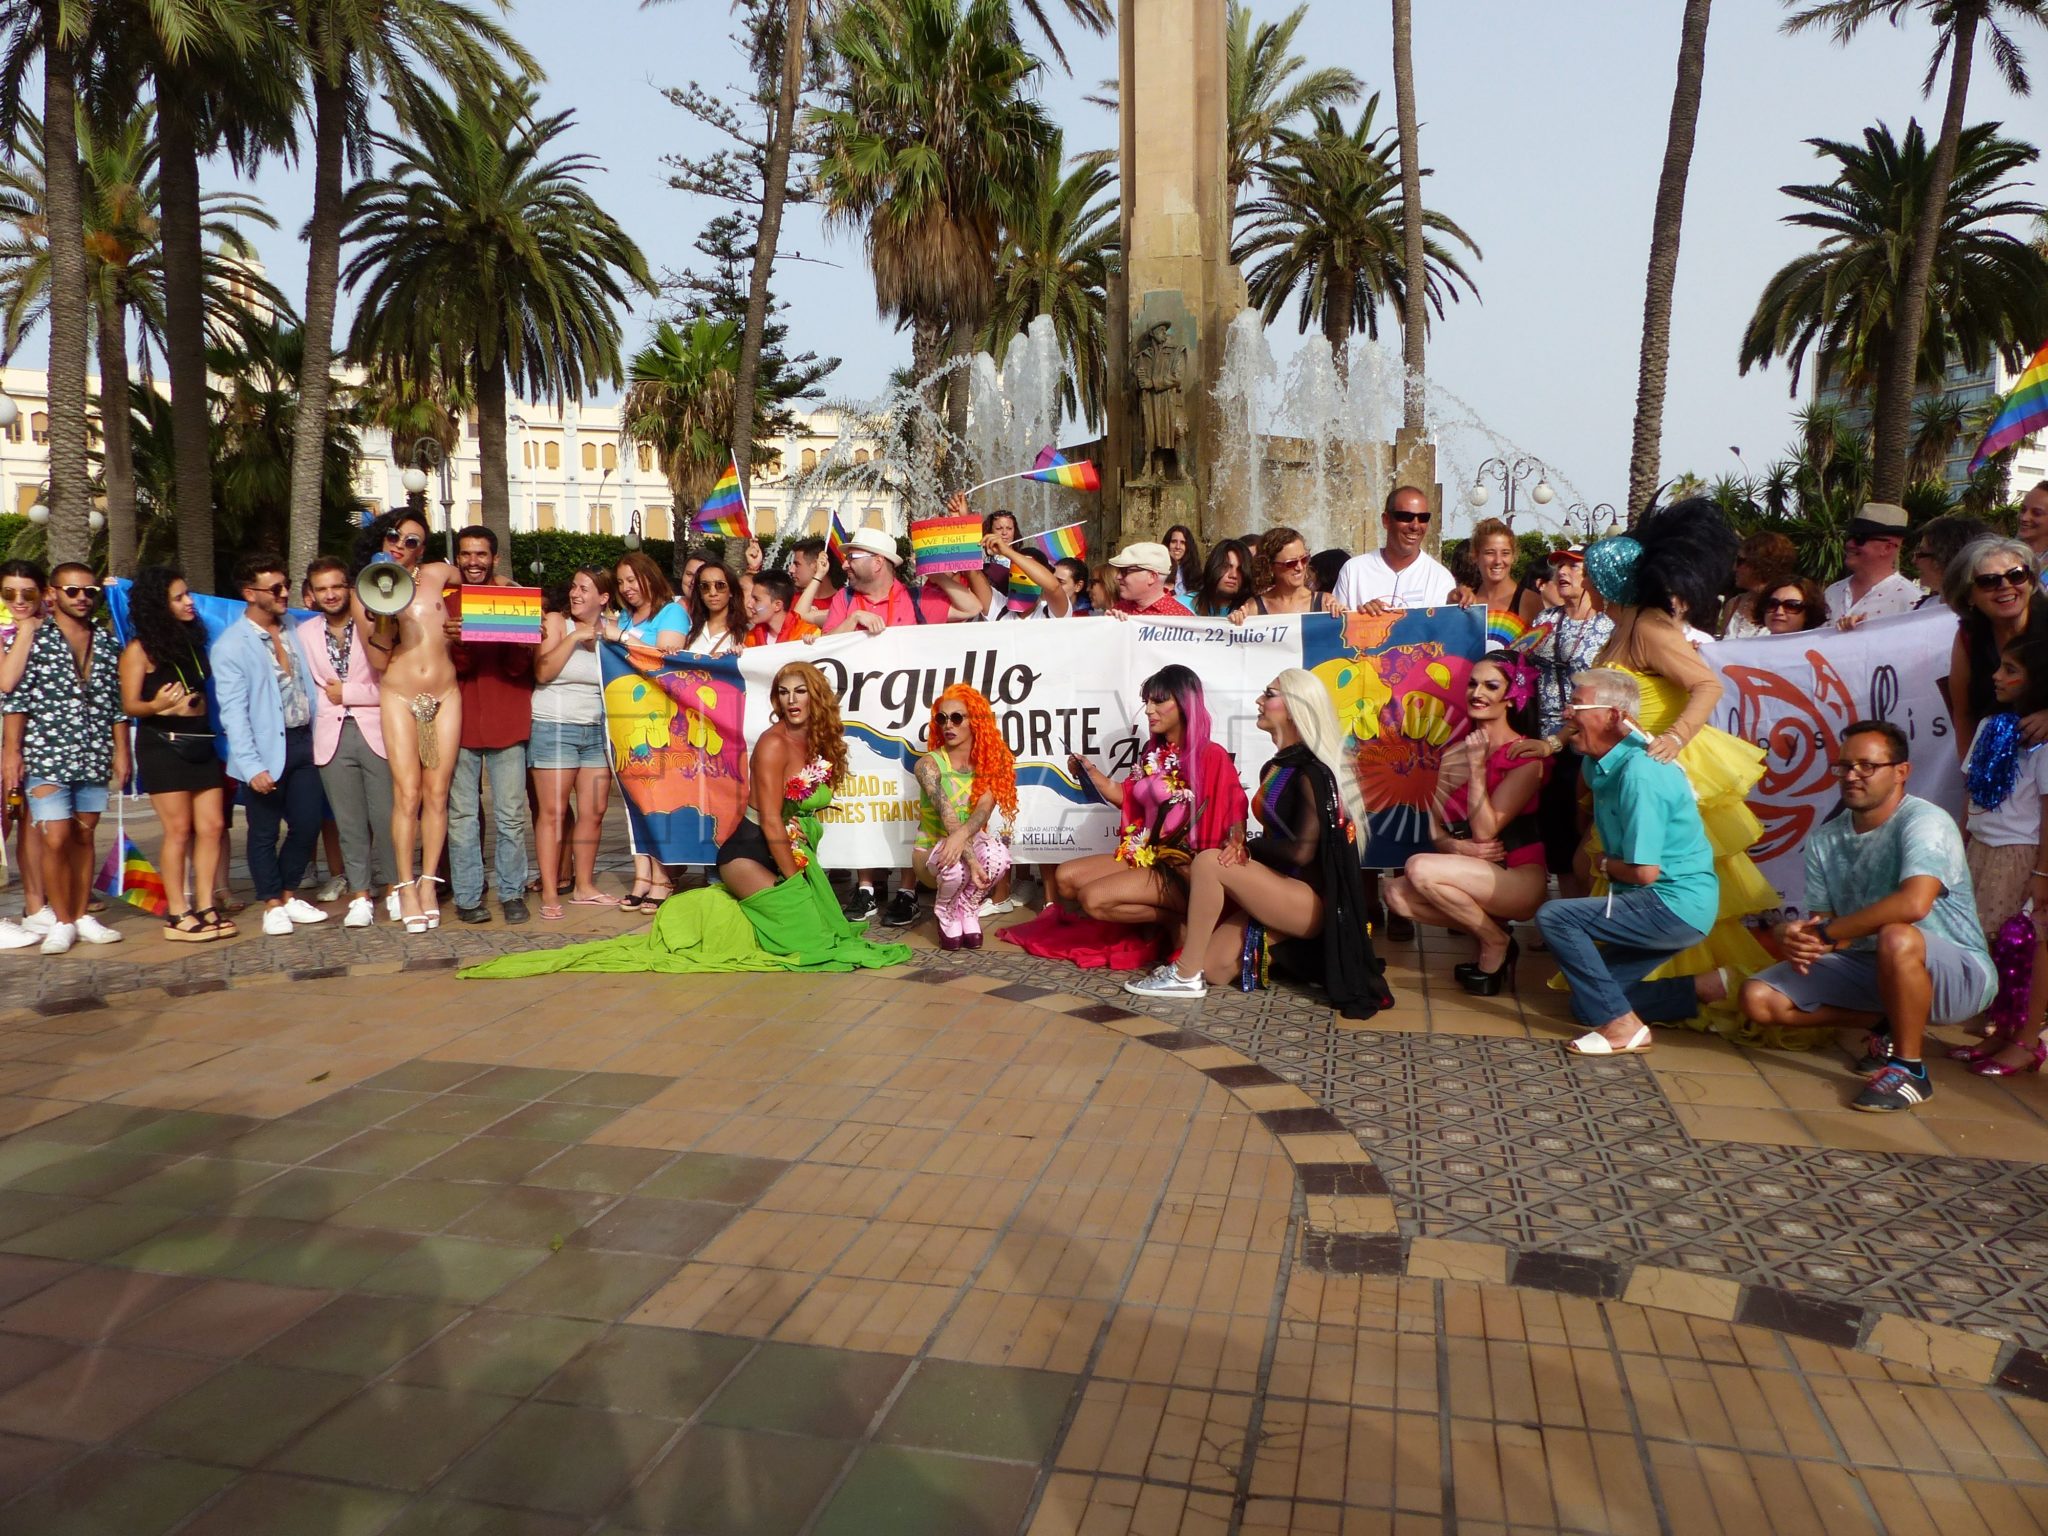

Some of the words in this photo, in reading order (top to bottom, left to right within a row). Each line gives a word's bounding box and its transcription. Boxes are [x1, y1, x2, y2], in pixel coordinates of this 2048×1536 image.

[922, 537, 938, 546] WE
[942, 535, 967, 544] FIGHT
[1138, 626, 1200, 644] Melilla,
[1205, 628, 1225, 642] 22
[989, 706, 1101, 758] ORTE
[882, 781, 898, 796] DE
[1022, 833, 1076, 845] MELILLA
